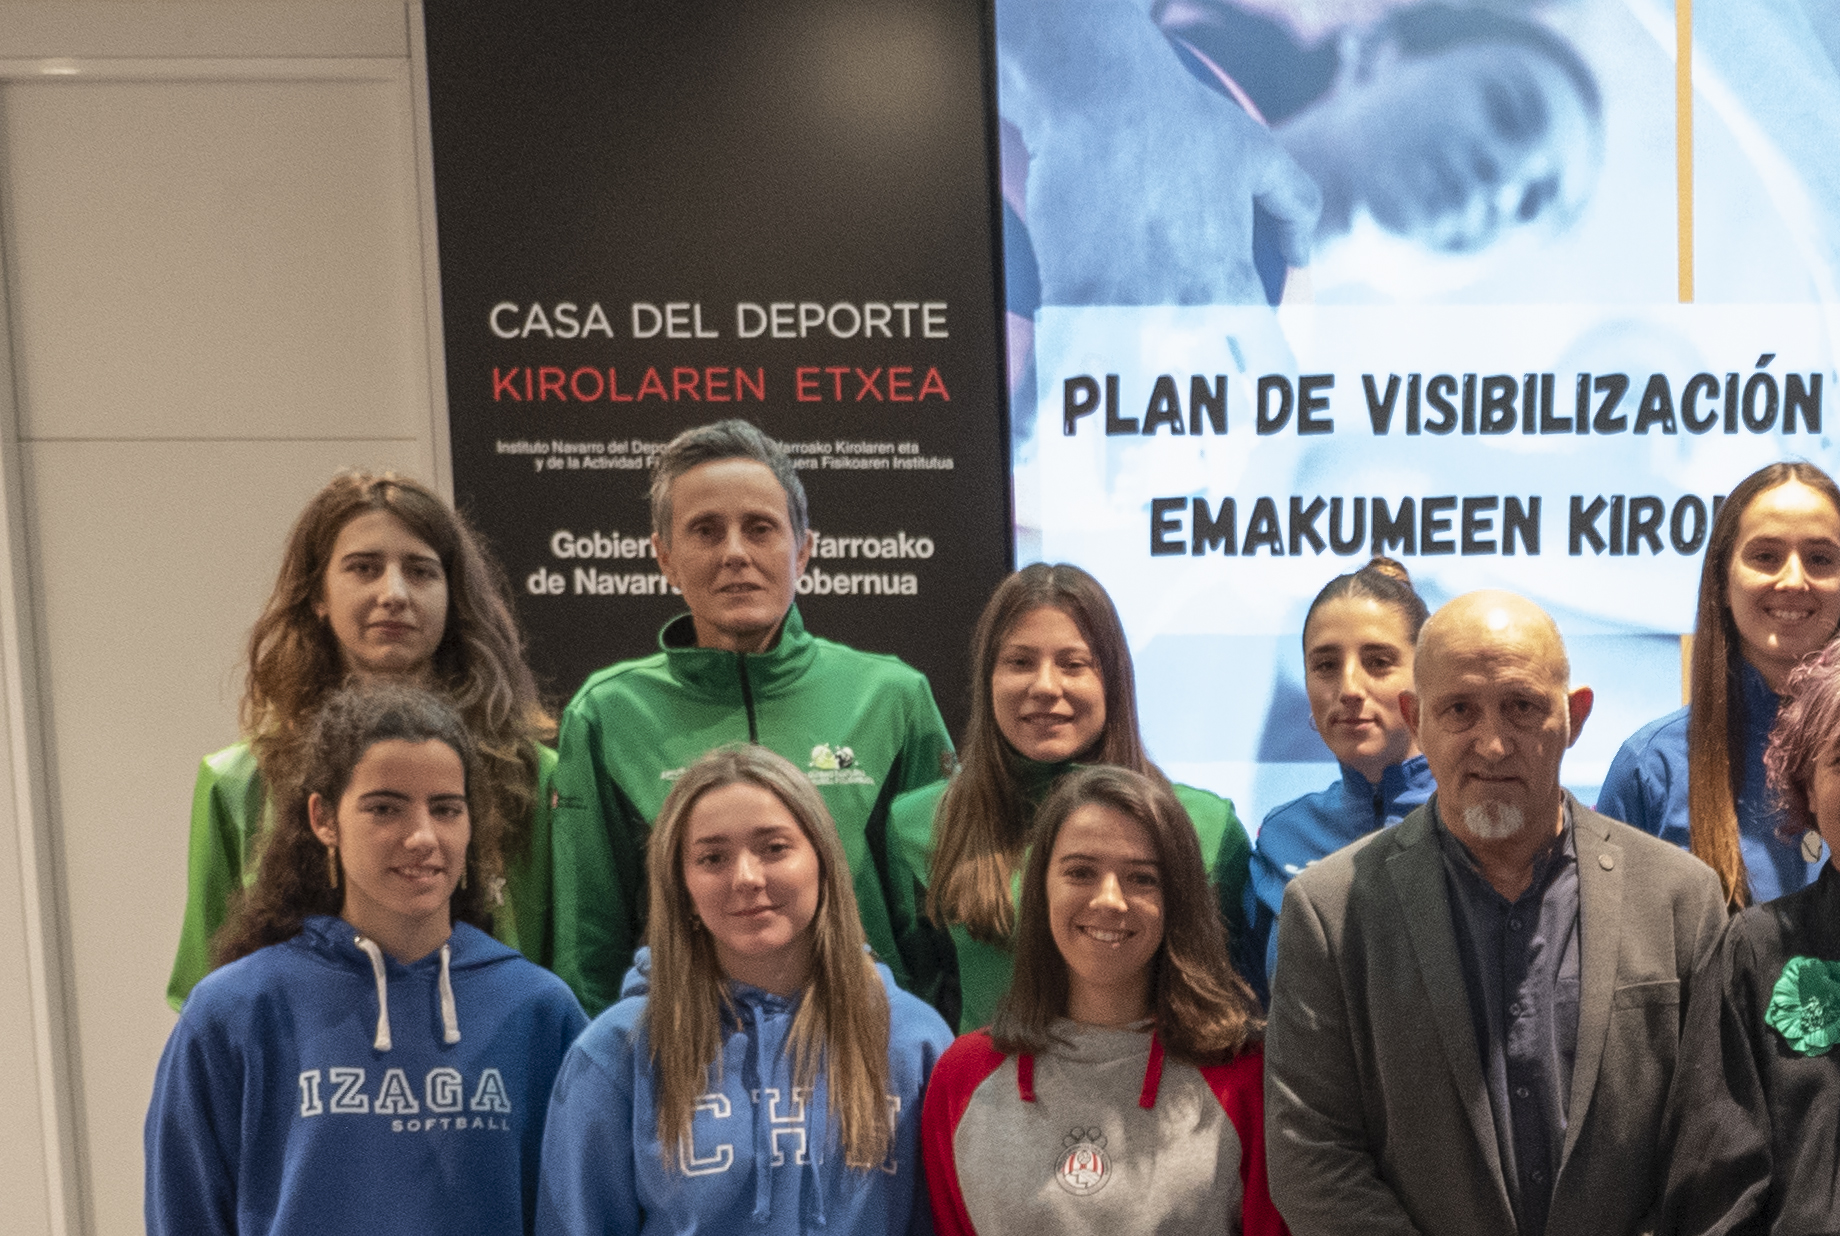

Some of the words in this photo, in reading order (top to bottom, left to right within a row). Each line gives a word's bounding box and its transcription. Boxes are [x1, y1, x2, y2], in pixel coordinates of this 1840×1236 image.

[489, 302, 613, 339] CASA
[631, 302, 719, 338] DEL
[736, 302, 950, 338] DEPORTE
[491, 366, 767, 402] KIROLAREN
[796, 366, 951, 402] ETXEA
[1062, 372, 1229, 437] PLAN
[1255, 372, 1336, 436] DE
[1361, 352, 1825, 437] VISIBILIZACIÓN
[496, 440, 550, 455] Instituto
[551, 440, 606, 455] Navarro
[607, 440, 629, 455] del
[835, 440, 895, 455] Kirolaren
[897, 441, 920, 455] eta
[534, 458, 545, 472] y
[546, 456, 565, 470] de
[566, 456, 581, 470] la
[582, 456, 643, 470] Actividad
[892, 457, 955, 470] Institutua
[1148, 493, 1543, 558] EMAKUMEEN
[1568, 493, 1728, 557] KIRO
[526, 566, 566, 595] de
[573, 566, 681, 596] Navarr
[298, 1066, 512, 1118] IZAGA
[391, 1116, 511, 1132] SOFTBALL
